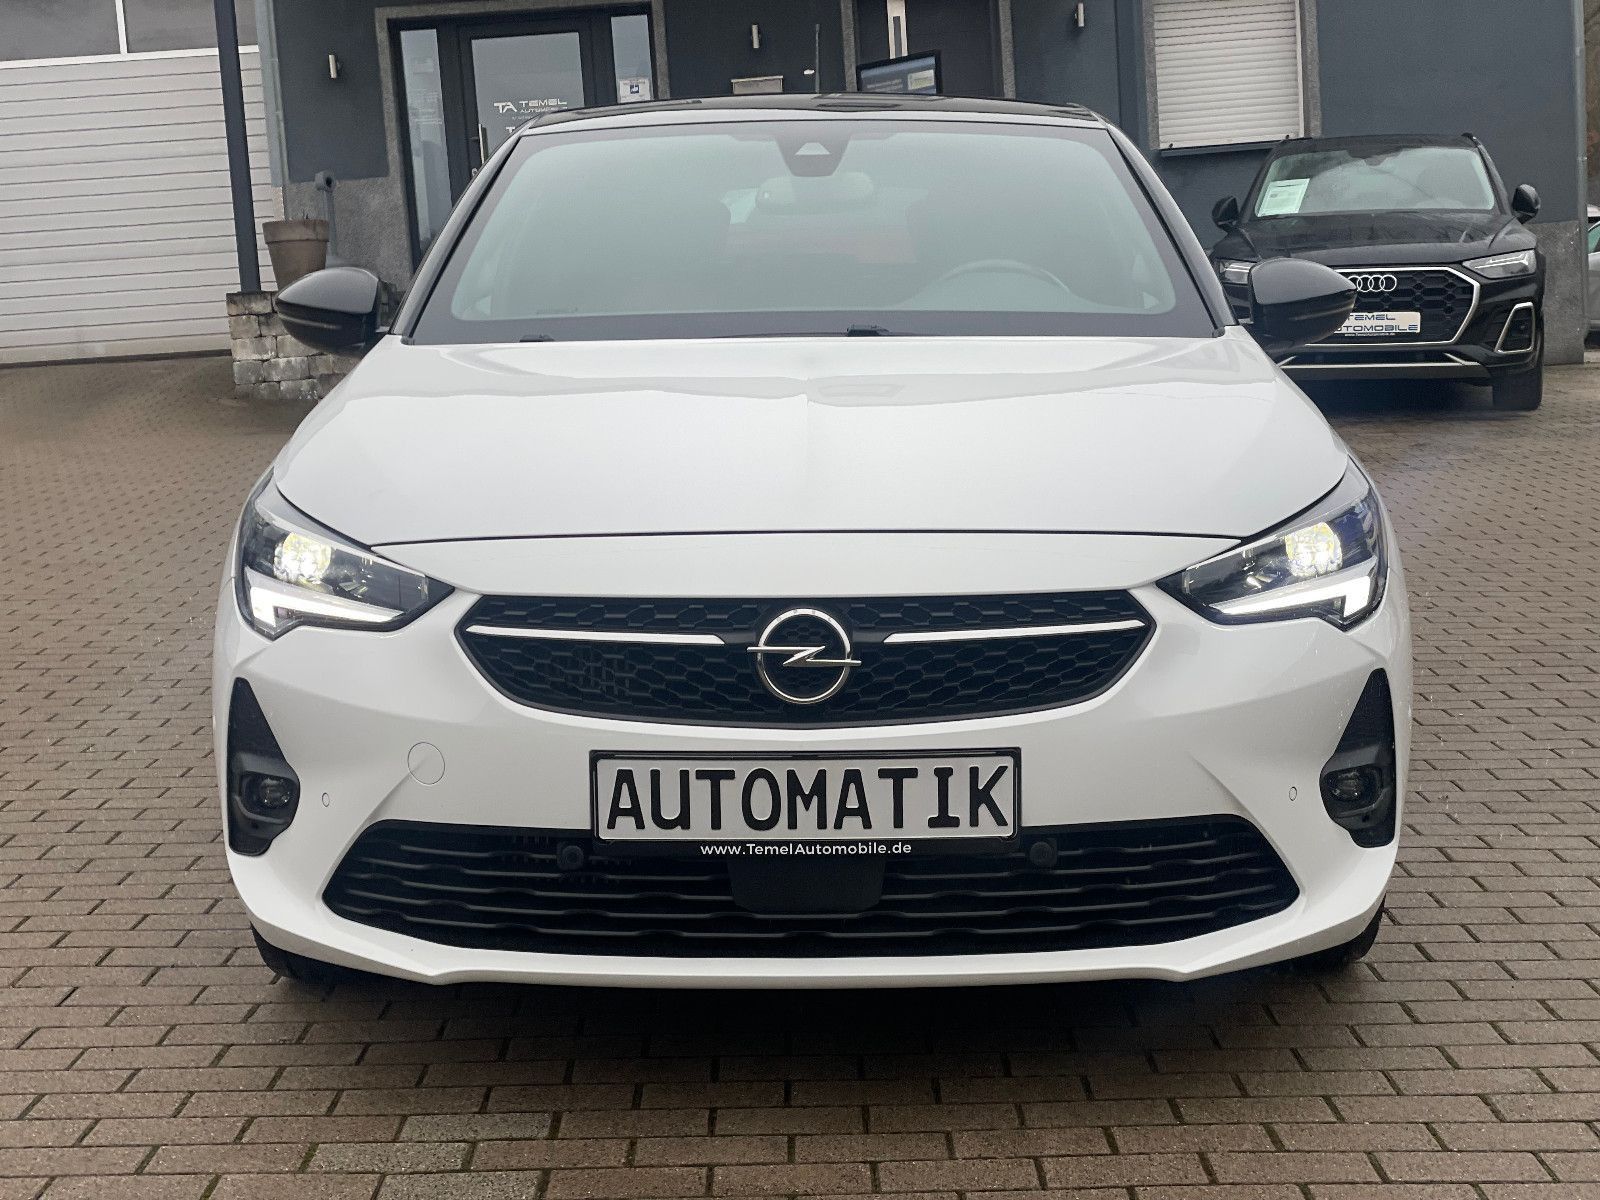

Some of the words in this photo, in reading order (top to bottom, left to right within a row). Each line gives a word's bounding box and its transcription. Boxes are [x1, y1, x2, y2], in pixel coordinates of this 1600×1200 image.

[493, 101, 518, 114] TA
[519, 98, 568, 108] TEMEL
[1336, 324, 1419, 332] TOMOBILE
[606, 765, 1009, 831] AUTOMATIK
[700, 841, 912, 855] www.TemelAutomobile.de
